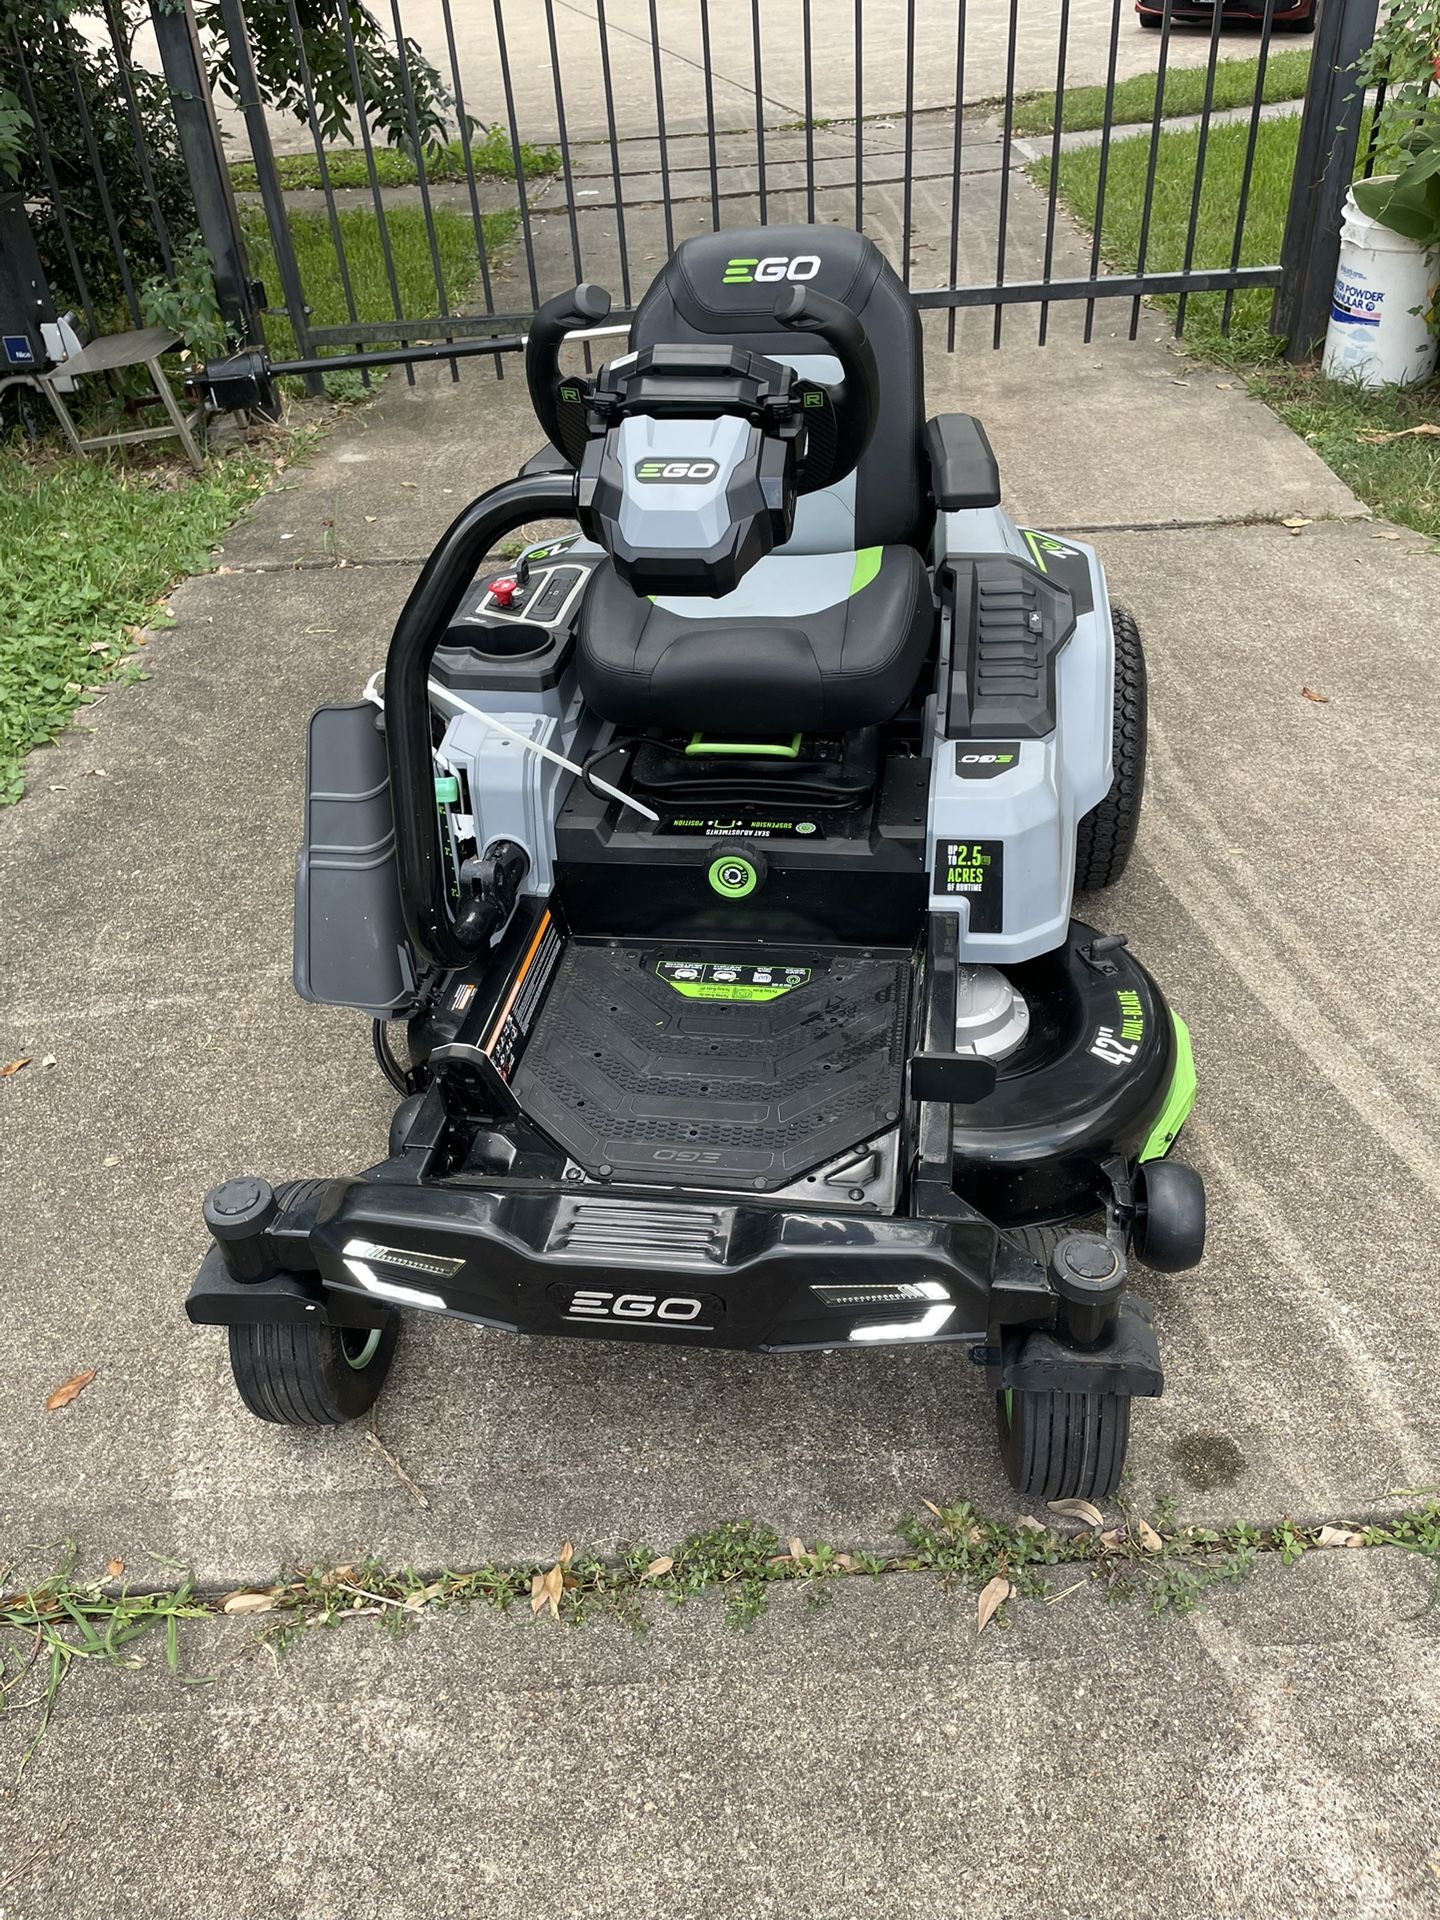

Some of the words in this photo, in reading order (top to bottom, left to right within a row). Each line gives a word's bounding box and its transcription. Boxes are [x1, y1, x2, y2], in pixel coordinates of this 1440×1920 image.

[722, 255, 821, 283] EGO
[1345, 285, 1384, 302] POWDER
[805, 394, 820, 405] R
[637, 463, 716, 478] EGO
[961, 754, 1014, 763] EGO
[751, 821, 792, 829] SUSPENSION
[706, 829, 753, 837] ADJUSTMENTS
[947, 845, 958, 855] UP
[957, 845, 982, 866] 2.5
[948, 855, 957, 866] TO
[947, 868, 984, 883] ACRES
[947, 883, 955, 891] OF
[955, 883, 982, 892] RUNTIME
[1090, 1026, 1139, 1066] 42"
[1116, 989, 1144, 1041] DUAL-BLADE
[652, 1149, 722, 1163] EGO
[569, 1290, 702, 1321] EGO
